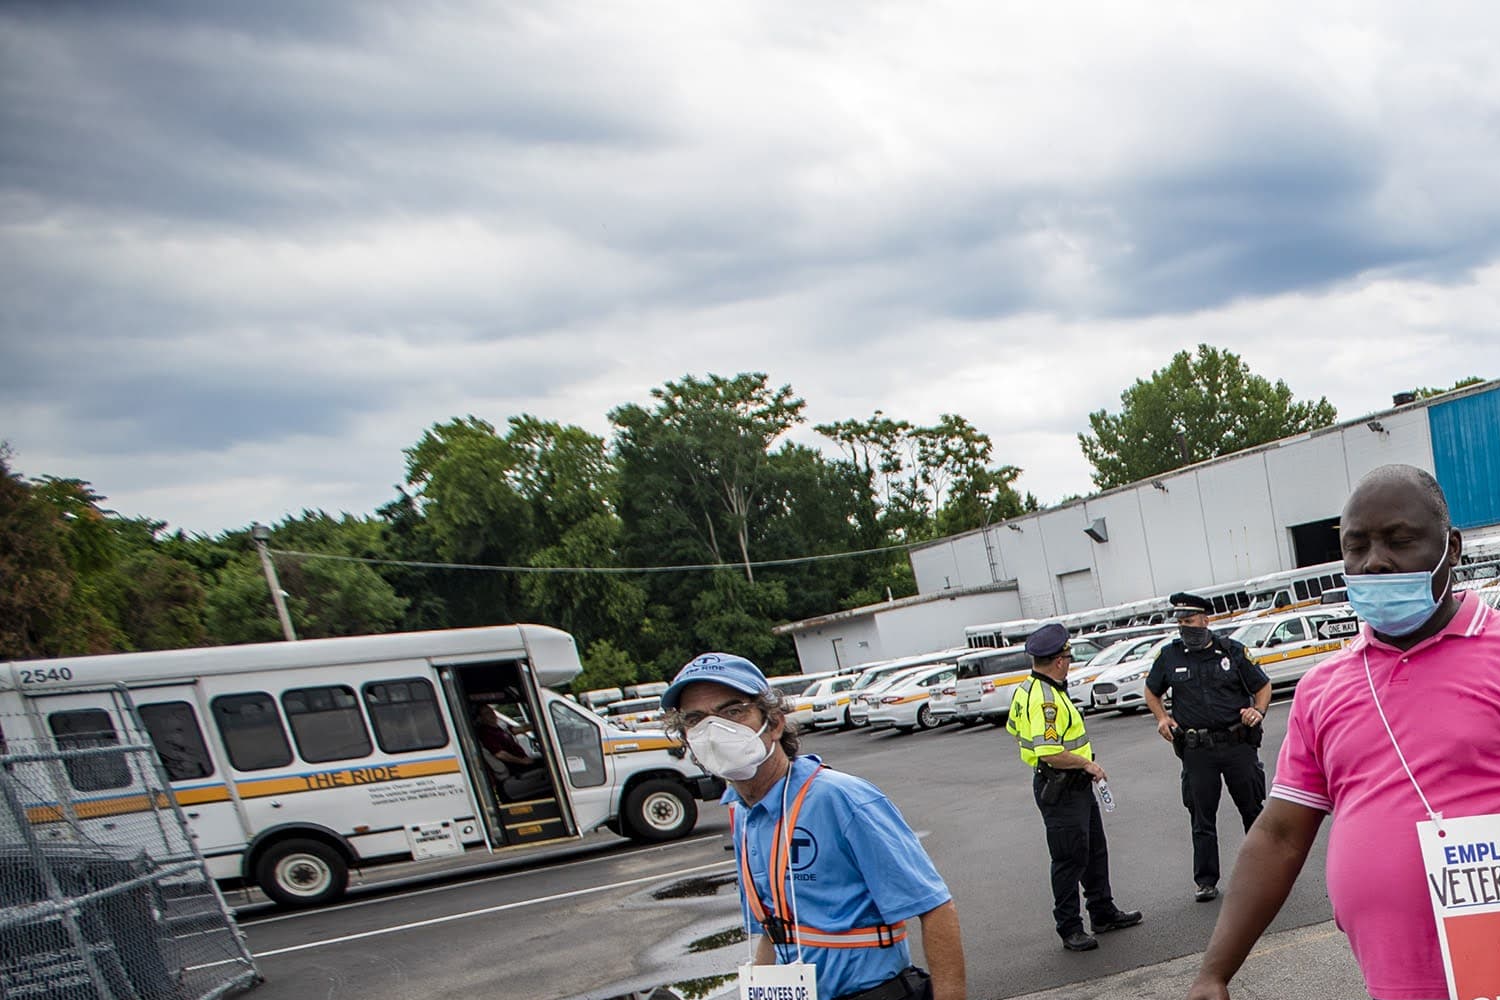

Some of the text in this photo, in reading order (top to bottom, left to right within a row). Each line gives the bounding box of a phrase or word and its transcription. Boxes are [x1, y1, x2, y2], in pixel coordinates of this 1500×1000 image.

[1328, 622, 1354, 634] ONE WAY
[20, 666, 73, 684] 2540
[300, 771, 346, 789] THE
[350, 765, 400, 785] RIDE
[794, 873, 817, 881] RIDE
